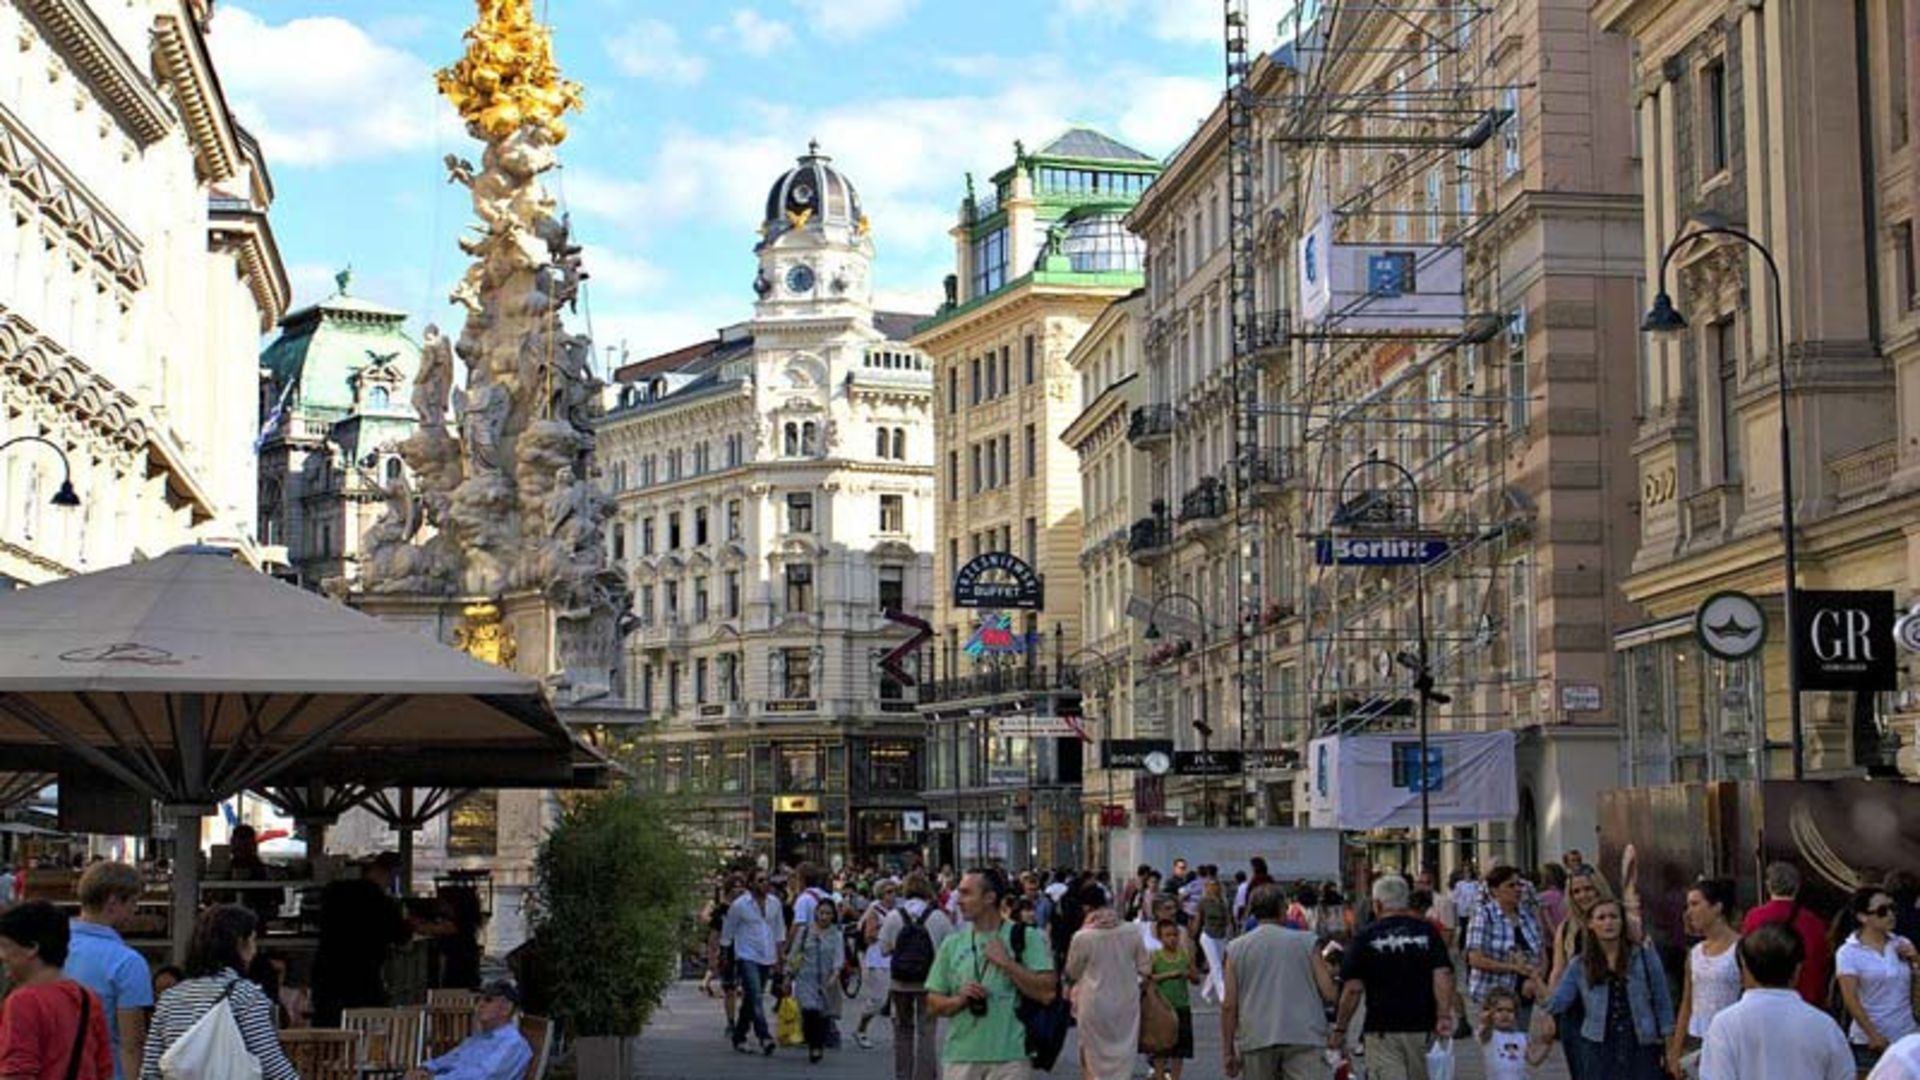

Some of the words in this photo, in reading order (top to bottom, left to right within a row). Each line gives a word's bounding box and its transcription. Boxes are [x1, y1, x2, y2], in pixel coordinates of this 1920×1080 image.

[1333, 539, 1428, 558] Berlitz
[973, 586, 1021, 598] BUFFET
[1811, 608, 1875, 661] GR
